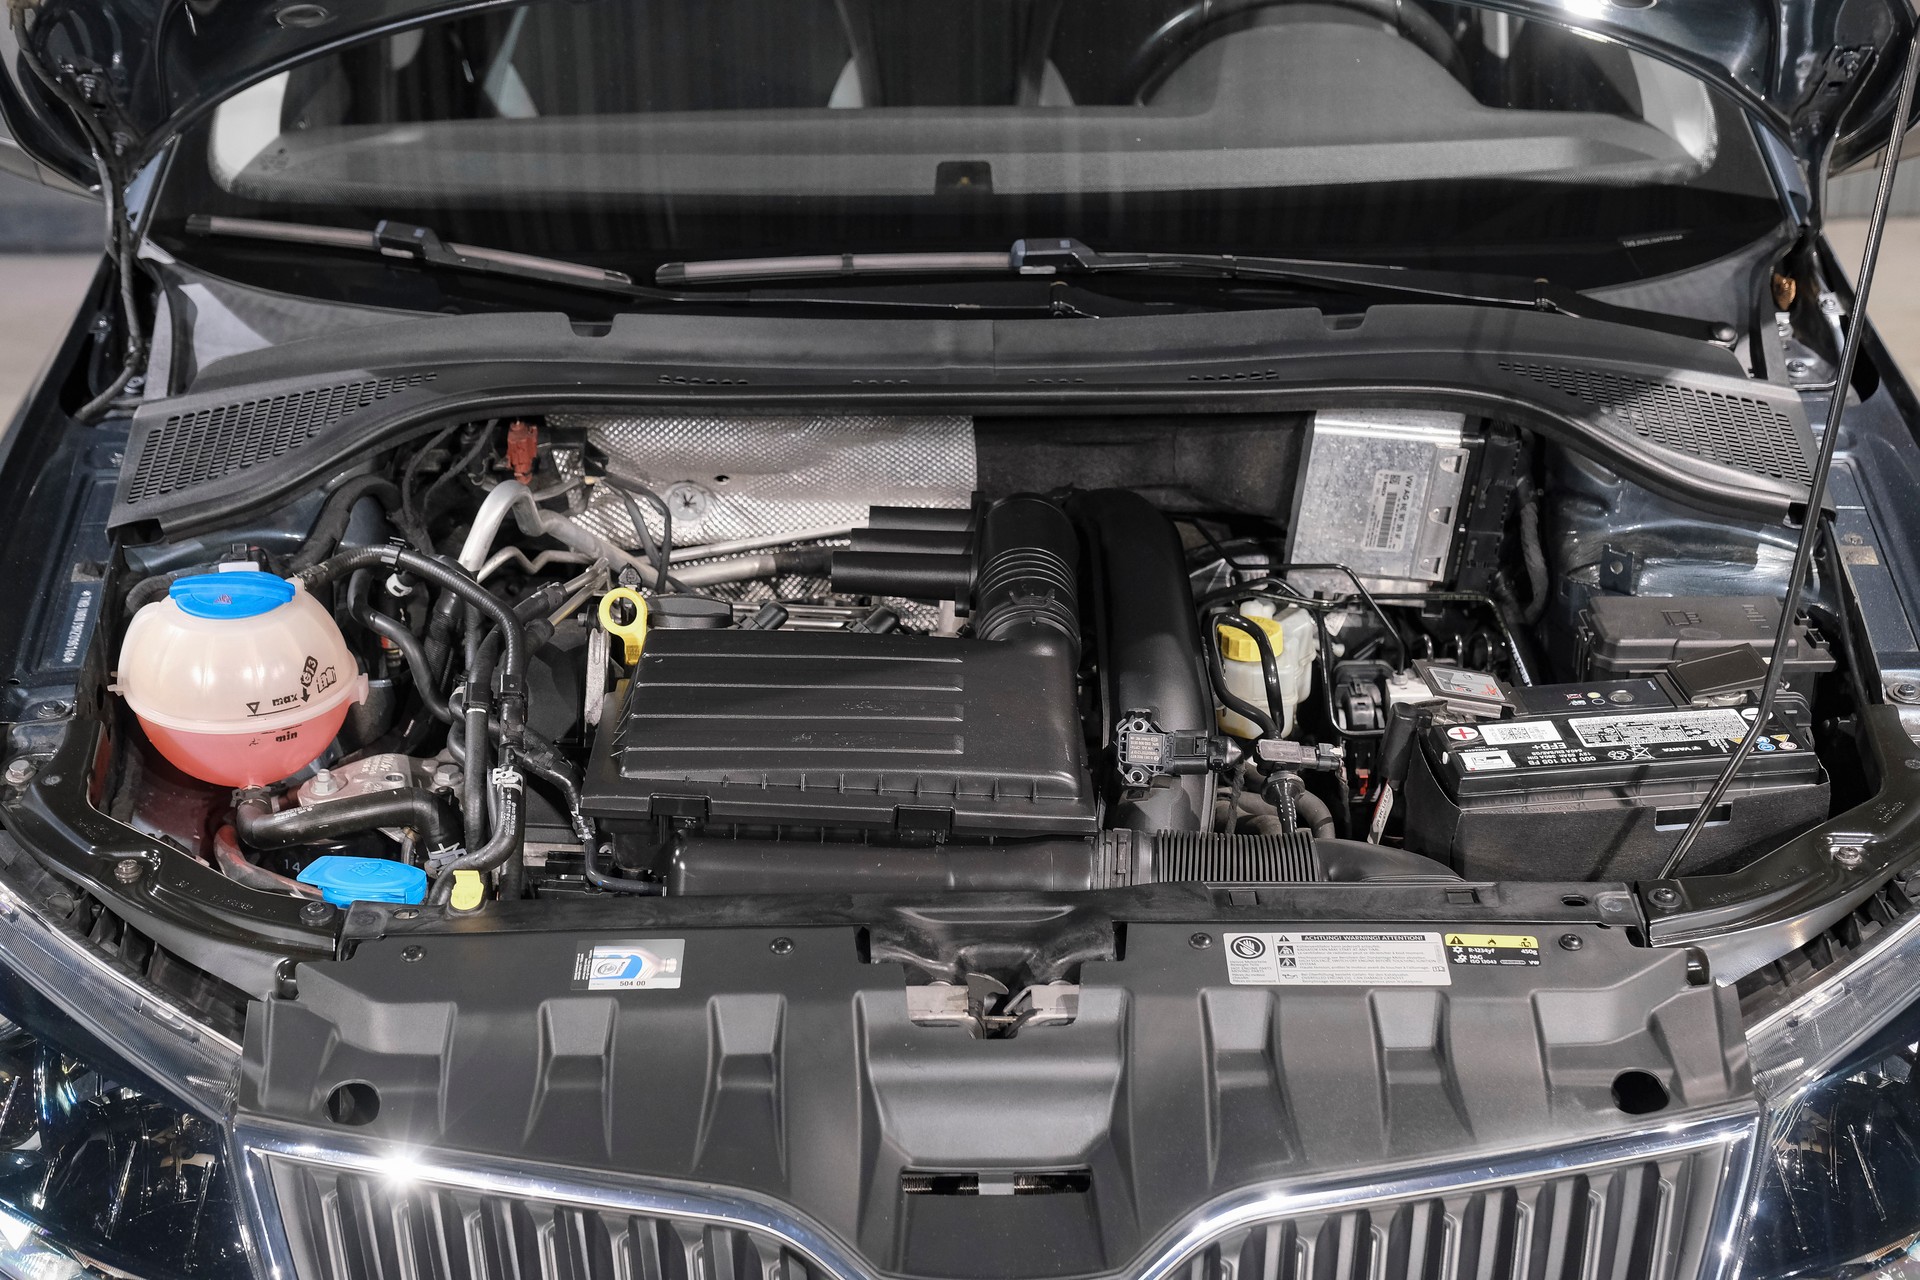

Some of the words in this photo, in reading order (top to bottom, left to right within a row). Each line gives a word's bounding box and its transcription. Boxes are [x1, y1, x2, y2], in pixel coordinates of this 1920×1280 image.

[272, 693, 299, 707] max
[275, 731, 298, 742] min
[1531, 741, 1567, 750] EFB+
[1468, 947, 1495, 955] R-1234yf
[1520, 948, 1538, 956] 450g
